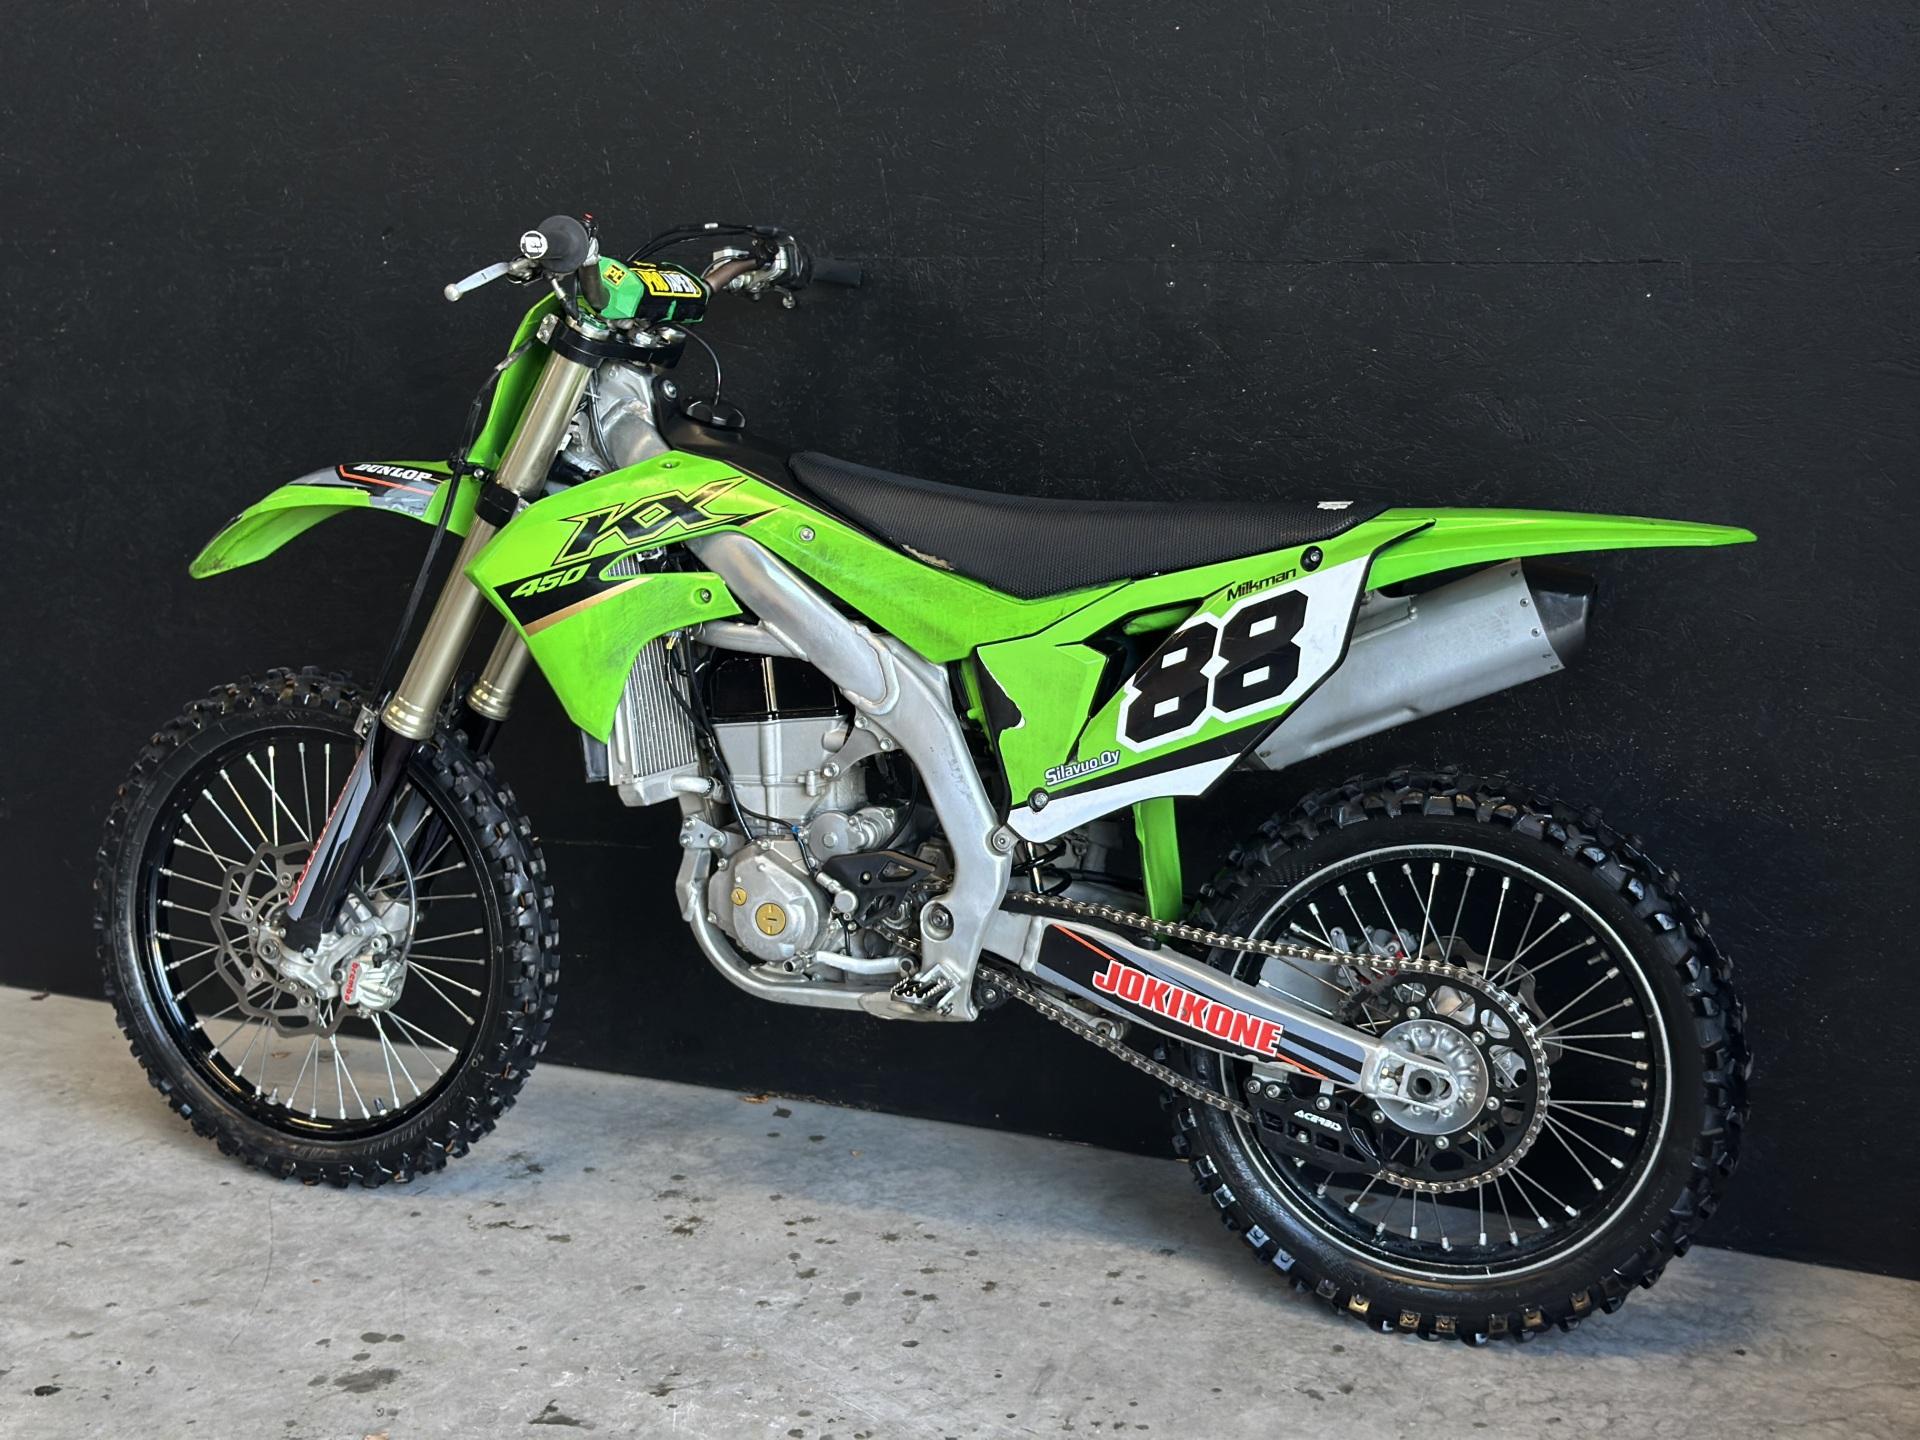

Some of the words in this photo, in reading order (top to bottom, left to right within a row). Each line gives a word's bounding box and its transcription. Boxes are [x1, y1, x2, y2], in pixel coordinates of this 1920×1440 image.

[353, 463, 433, 482] DUNLOP
[551, 476, 748, 567] KX
[510, 563, 592, 598] 450
[1226, 568, 1297, 602] Milkman
[1124, 588, 1309, 744] 88
[1045, 758, 1098, 783] Silavuo
[1100, 750, 1120, 764] Oy
[1092, 960, 1283, 1056] JOKIKONE
